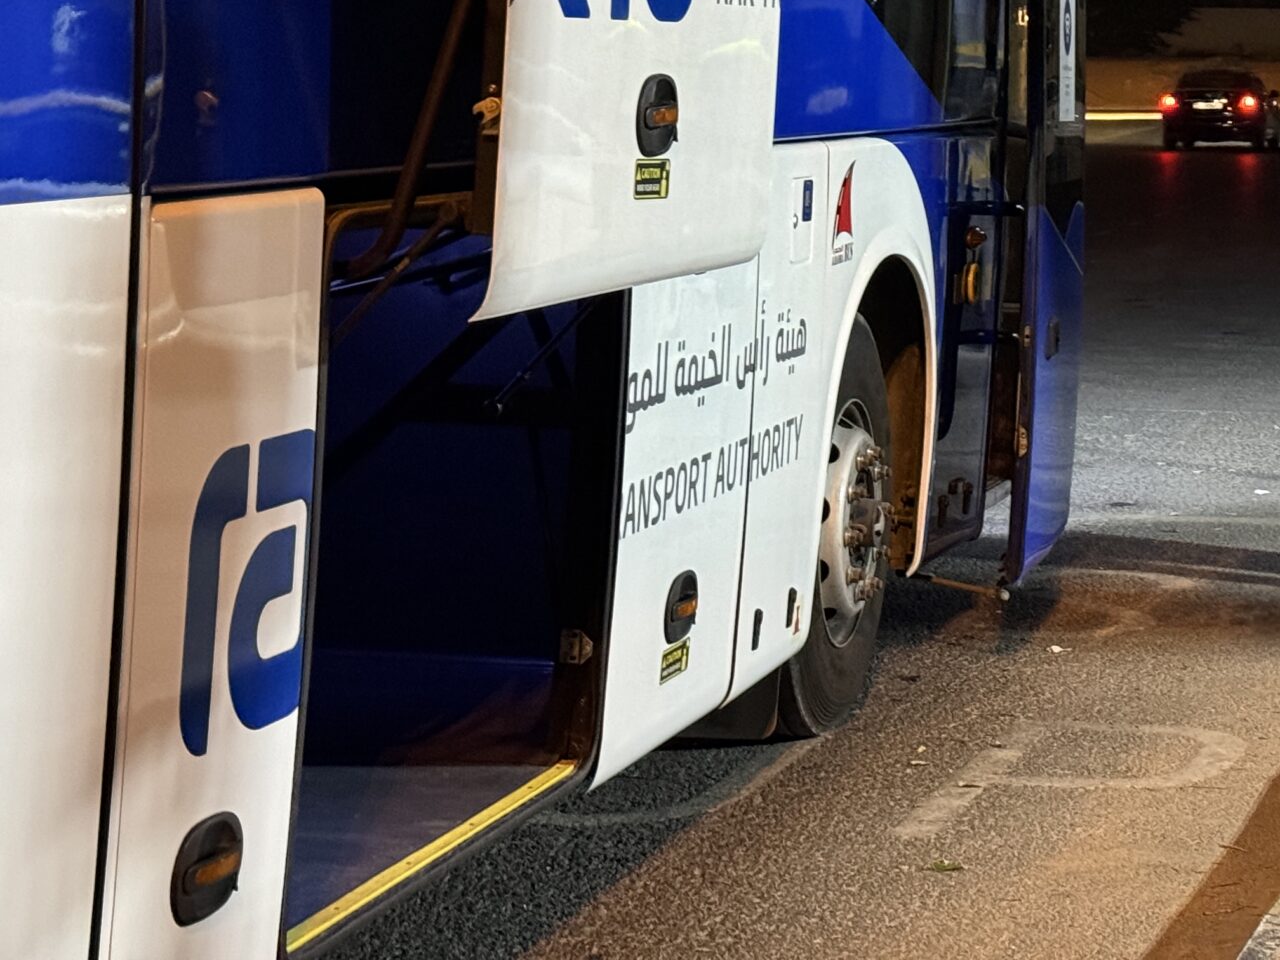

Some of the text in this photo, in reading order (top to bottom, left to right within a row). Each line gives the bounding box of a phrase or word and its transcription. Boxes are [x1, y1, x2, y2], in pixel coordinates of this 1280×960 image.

[674, 322, 732, 408] الخيمة
[736, 299, 770, 390] رأس
[775, 308, 807, 376] هيئة
[620, 413, 803, 540] ANSPORT AUTHORITY
